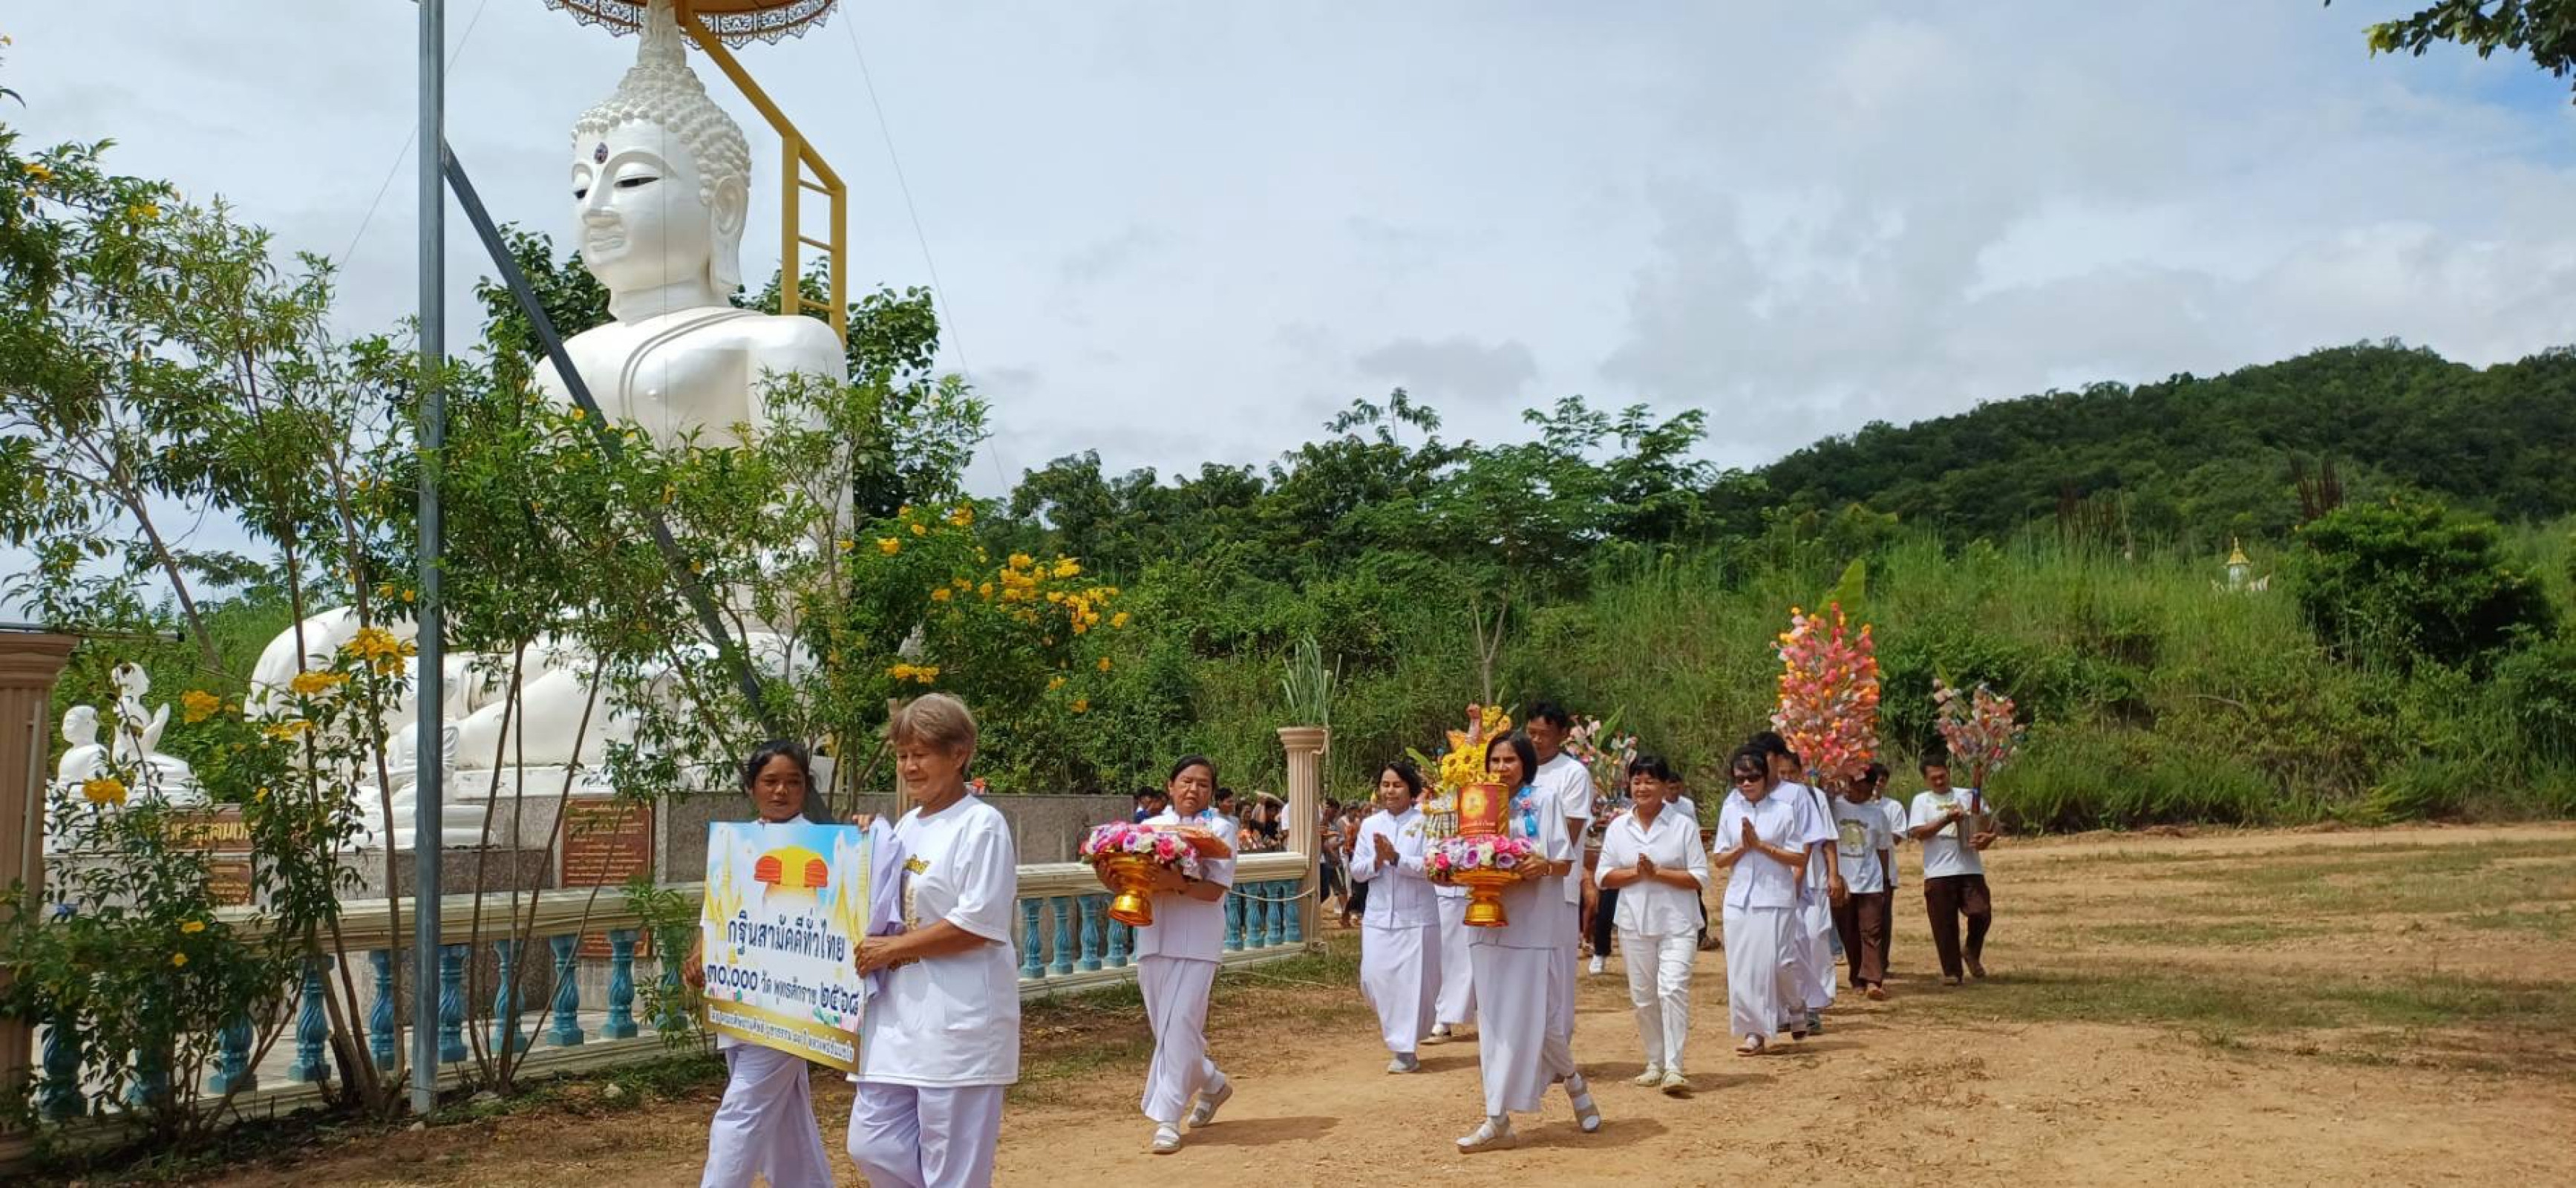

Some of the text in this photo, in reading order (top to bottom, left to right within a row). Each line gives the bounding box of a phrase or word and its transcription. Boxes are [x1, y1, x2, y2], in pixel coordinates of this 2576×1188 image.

[728, 907, 845, 962] กฐินสามัคคีทั่วไทย
[761, 970, 771, 994] วัด
[773, 976, 817, 1005] พุทธศักราช
[820, 982, 859, 1016] ๒๕๖๘
